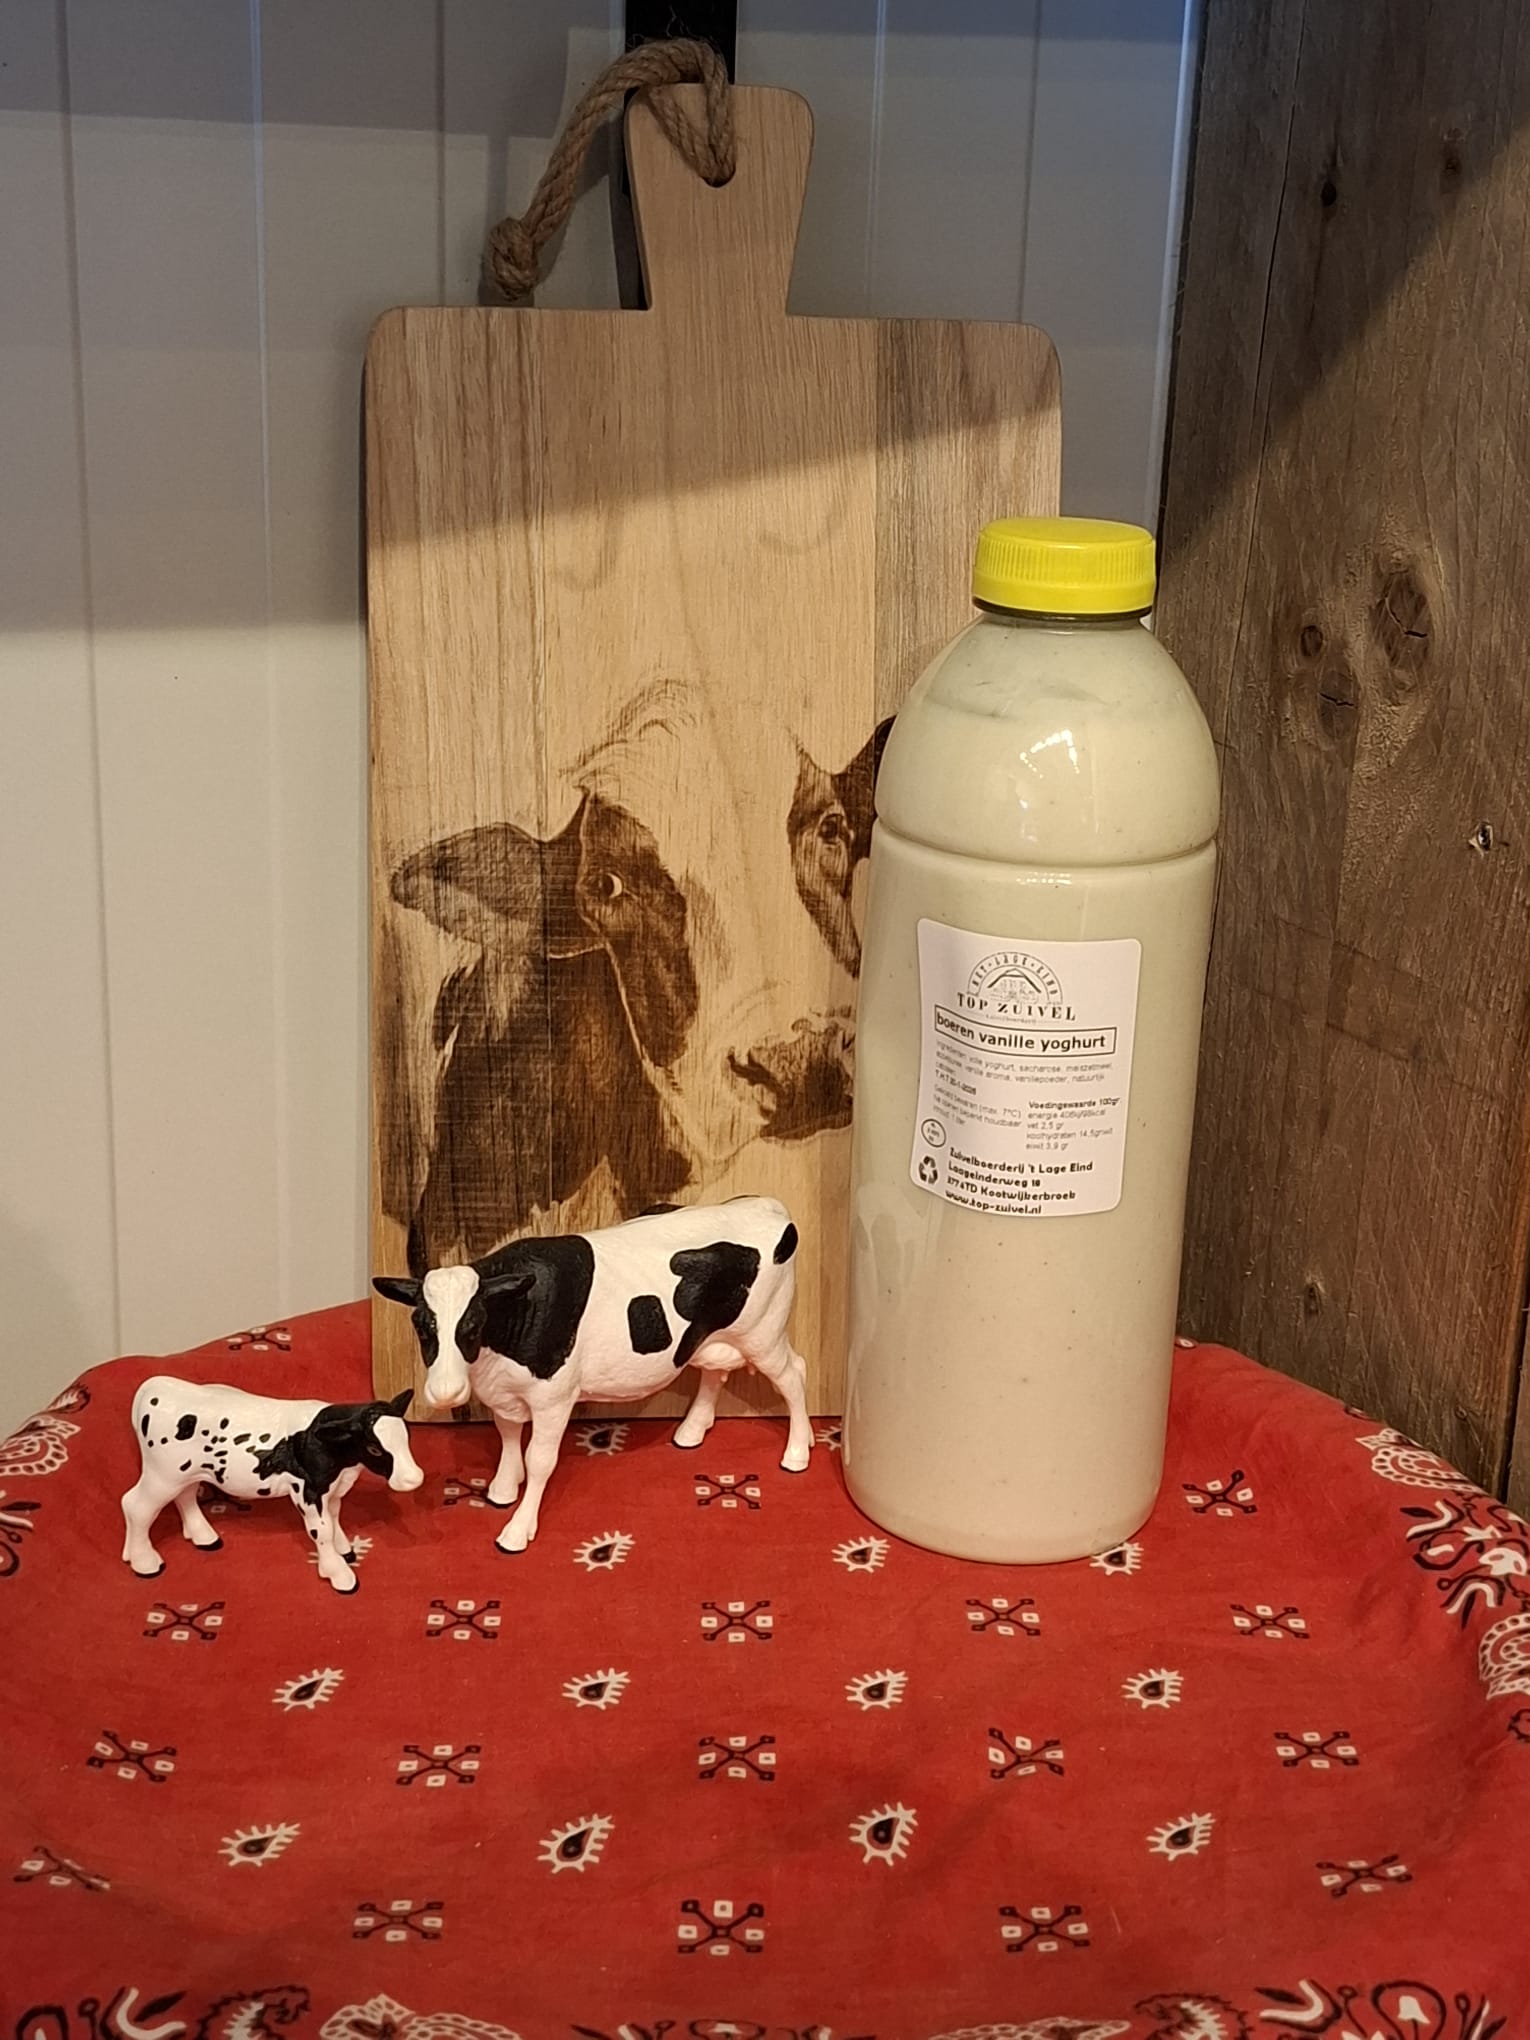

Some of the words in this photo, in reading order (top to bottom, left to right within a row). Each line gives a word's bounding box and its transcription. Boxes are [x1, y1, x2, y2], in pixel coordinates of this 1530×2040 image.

[995, 955, 1027, 965] LAGE
[957, 992, 988, 1010] TOP
[998, 1002, 1076, 1021] ZUIVEL
[936, 1011, 975, 1041] boeren
[979, 1030, 1035, 1050] vanille
[1040, 1034, 1106, 1053] yoghurt
[949, 1147, 1025, 1174] Zuivelboerderij
[1039, 1164, 1067, 1175] Lage
[1070, 1162, 1093, 1173] Eind
[949, 1161, 1028, 1188] Laageinderweg
[945, 1190, 1042, 1214] www.top-zuivel.nl
[980, 1186, 1076, 1202] Kootwijkerbroek
